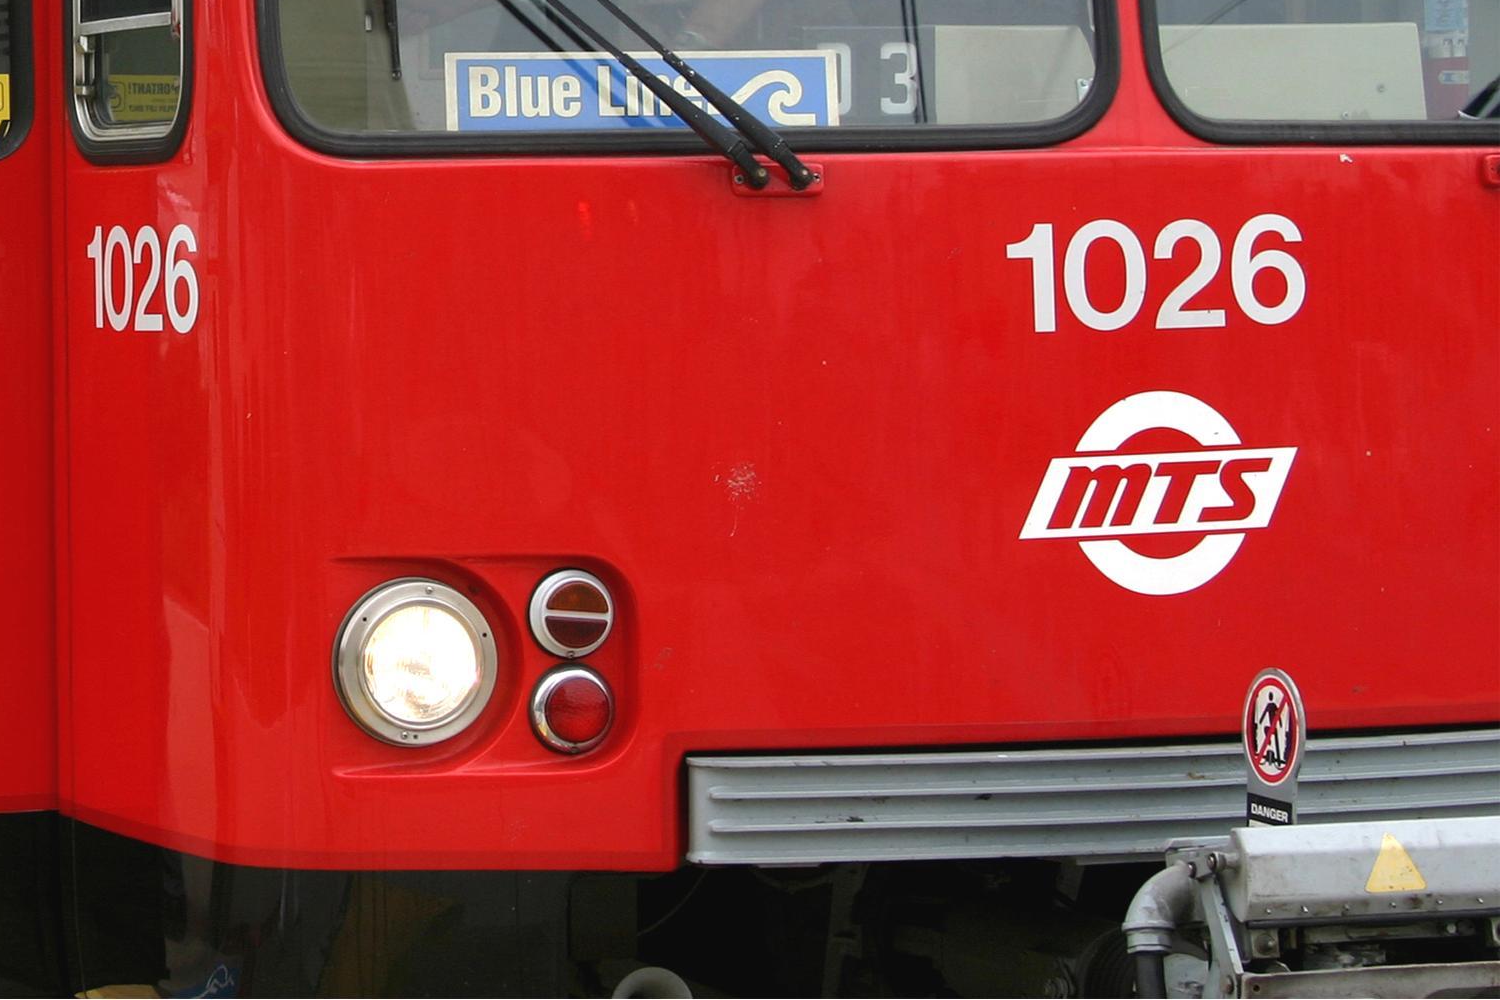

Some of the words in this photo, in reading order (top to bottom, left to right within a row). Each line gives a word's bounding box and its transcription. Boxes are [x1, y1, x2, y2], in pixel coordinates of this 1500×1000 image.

[468, 65, 582, 118] Blue
[86, 223, 199, 334] 1026
[1005, 213, 1307, 333] 1026
[1250, 802, 1290, 823] DANGER
